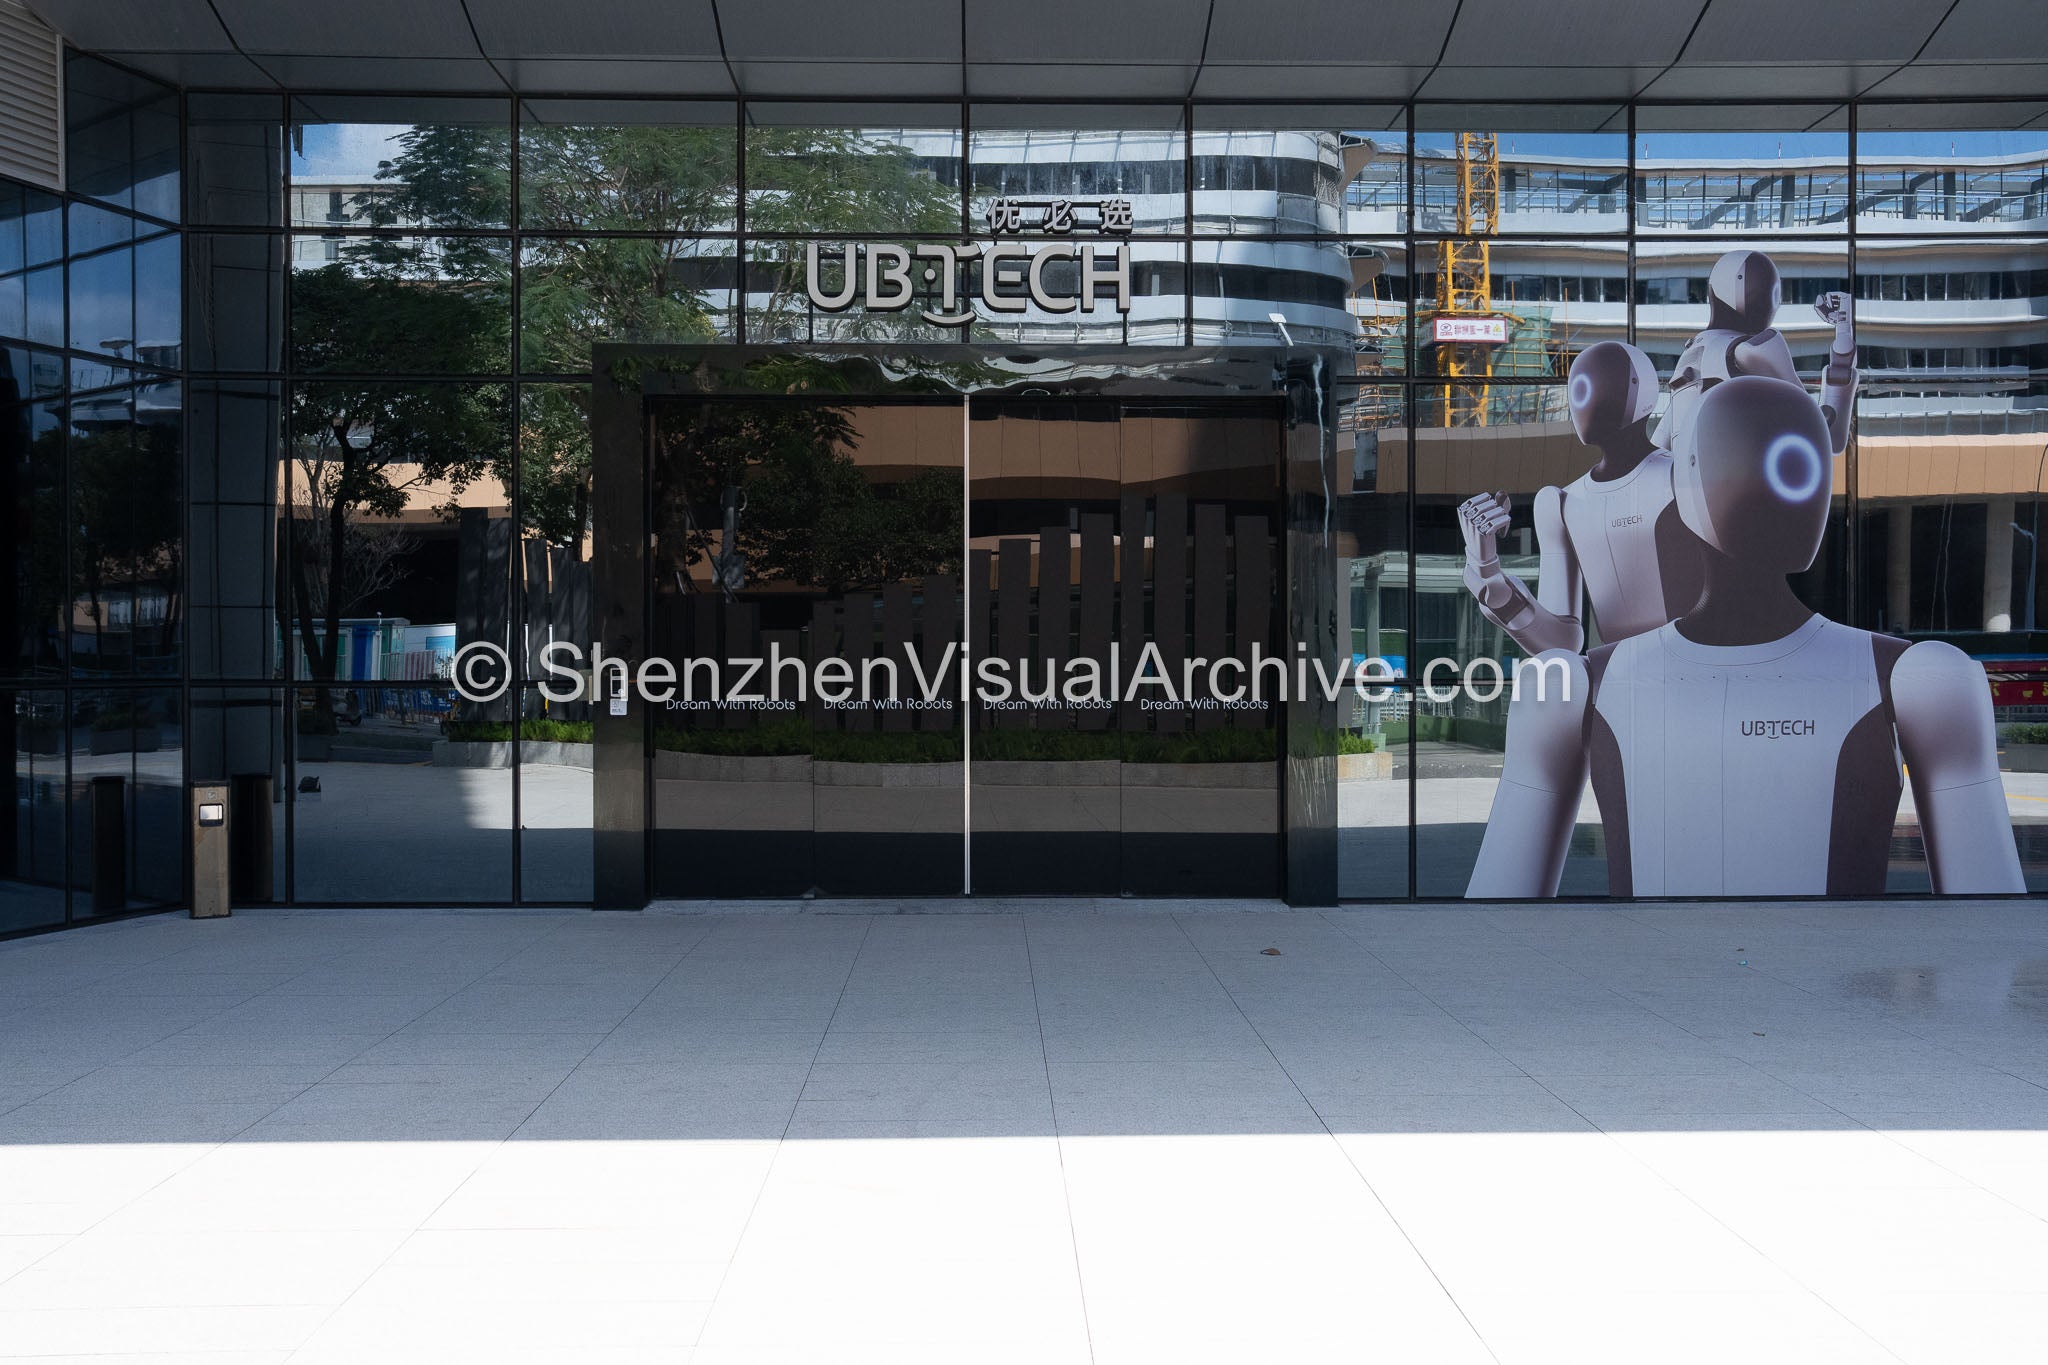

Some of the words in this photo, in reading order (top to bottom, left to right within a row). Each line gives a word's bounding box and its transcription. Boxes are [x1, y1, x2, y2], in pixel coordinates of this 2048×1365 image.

[987, 199, 1134, 234] 优必选
[806, 243, 1132, 326] UBTECH
[1611, 514, 1643, 528] UBTECH
[666, 699, 710, 710] Dream
[714, 698, 745, 710] With
[749, 698, 796, 710] Robots
[824, 699, 868, 710] Dream
[872, 698, 903, 710] With
[906, 698, 953, 710] Robots
[983, 699, 1027, 710] Dream
[1031, 697, 1062, 710] With
[1066, 697, 1112, 710] Robots
[1140, 699, 1184, 710] Dream
[1188, 697, 1219, 710] With
[1223, 698, 1269, 710] Robots
[1741, 719, 1815, 739] UBTECH
